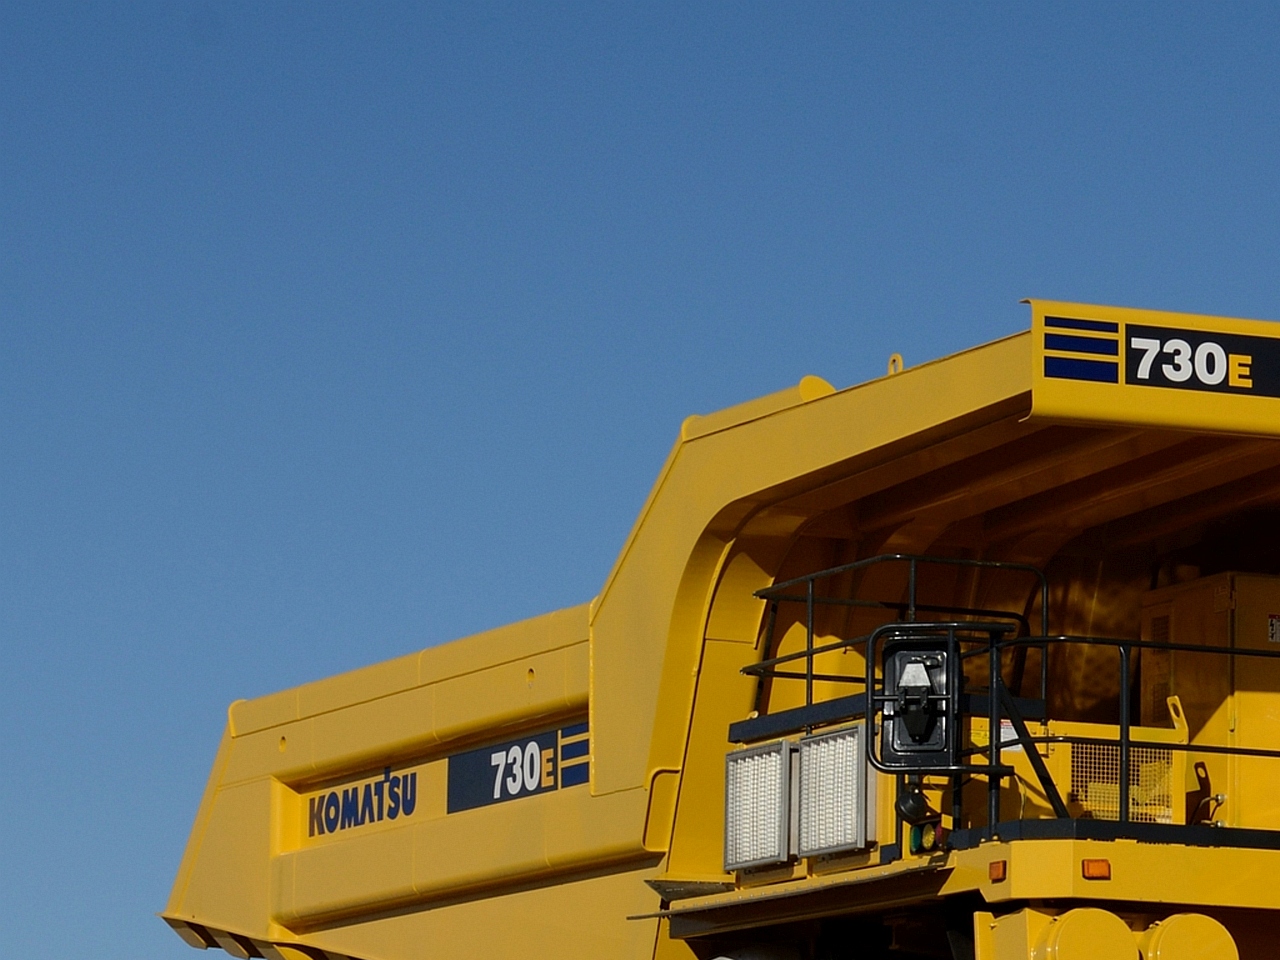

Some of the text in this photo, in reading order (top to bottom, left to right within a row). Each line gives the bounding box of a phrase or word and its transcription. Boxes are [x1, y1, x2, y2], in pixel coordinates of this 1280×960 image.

[1130, 337, 1253, 389] 730E
[490, 740, 555, 799] 730E
[308, 766, 417, 838] KOMATSU
